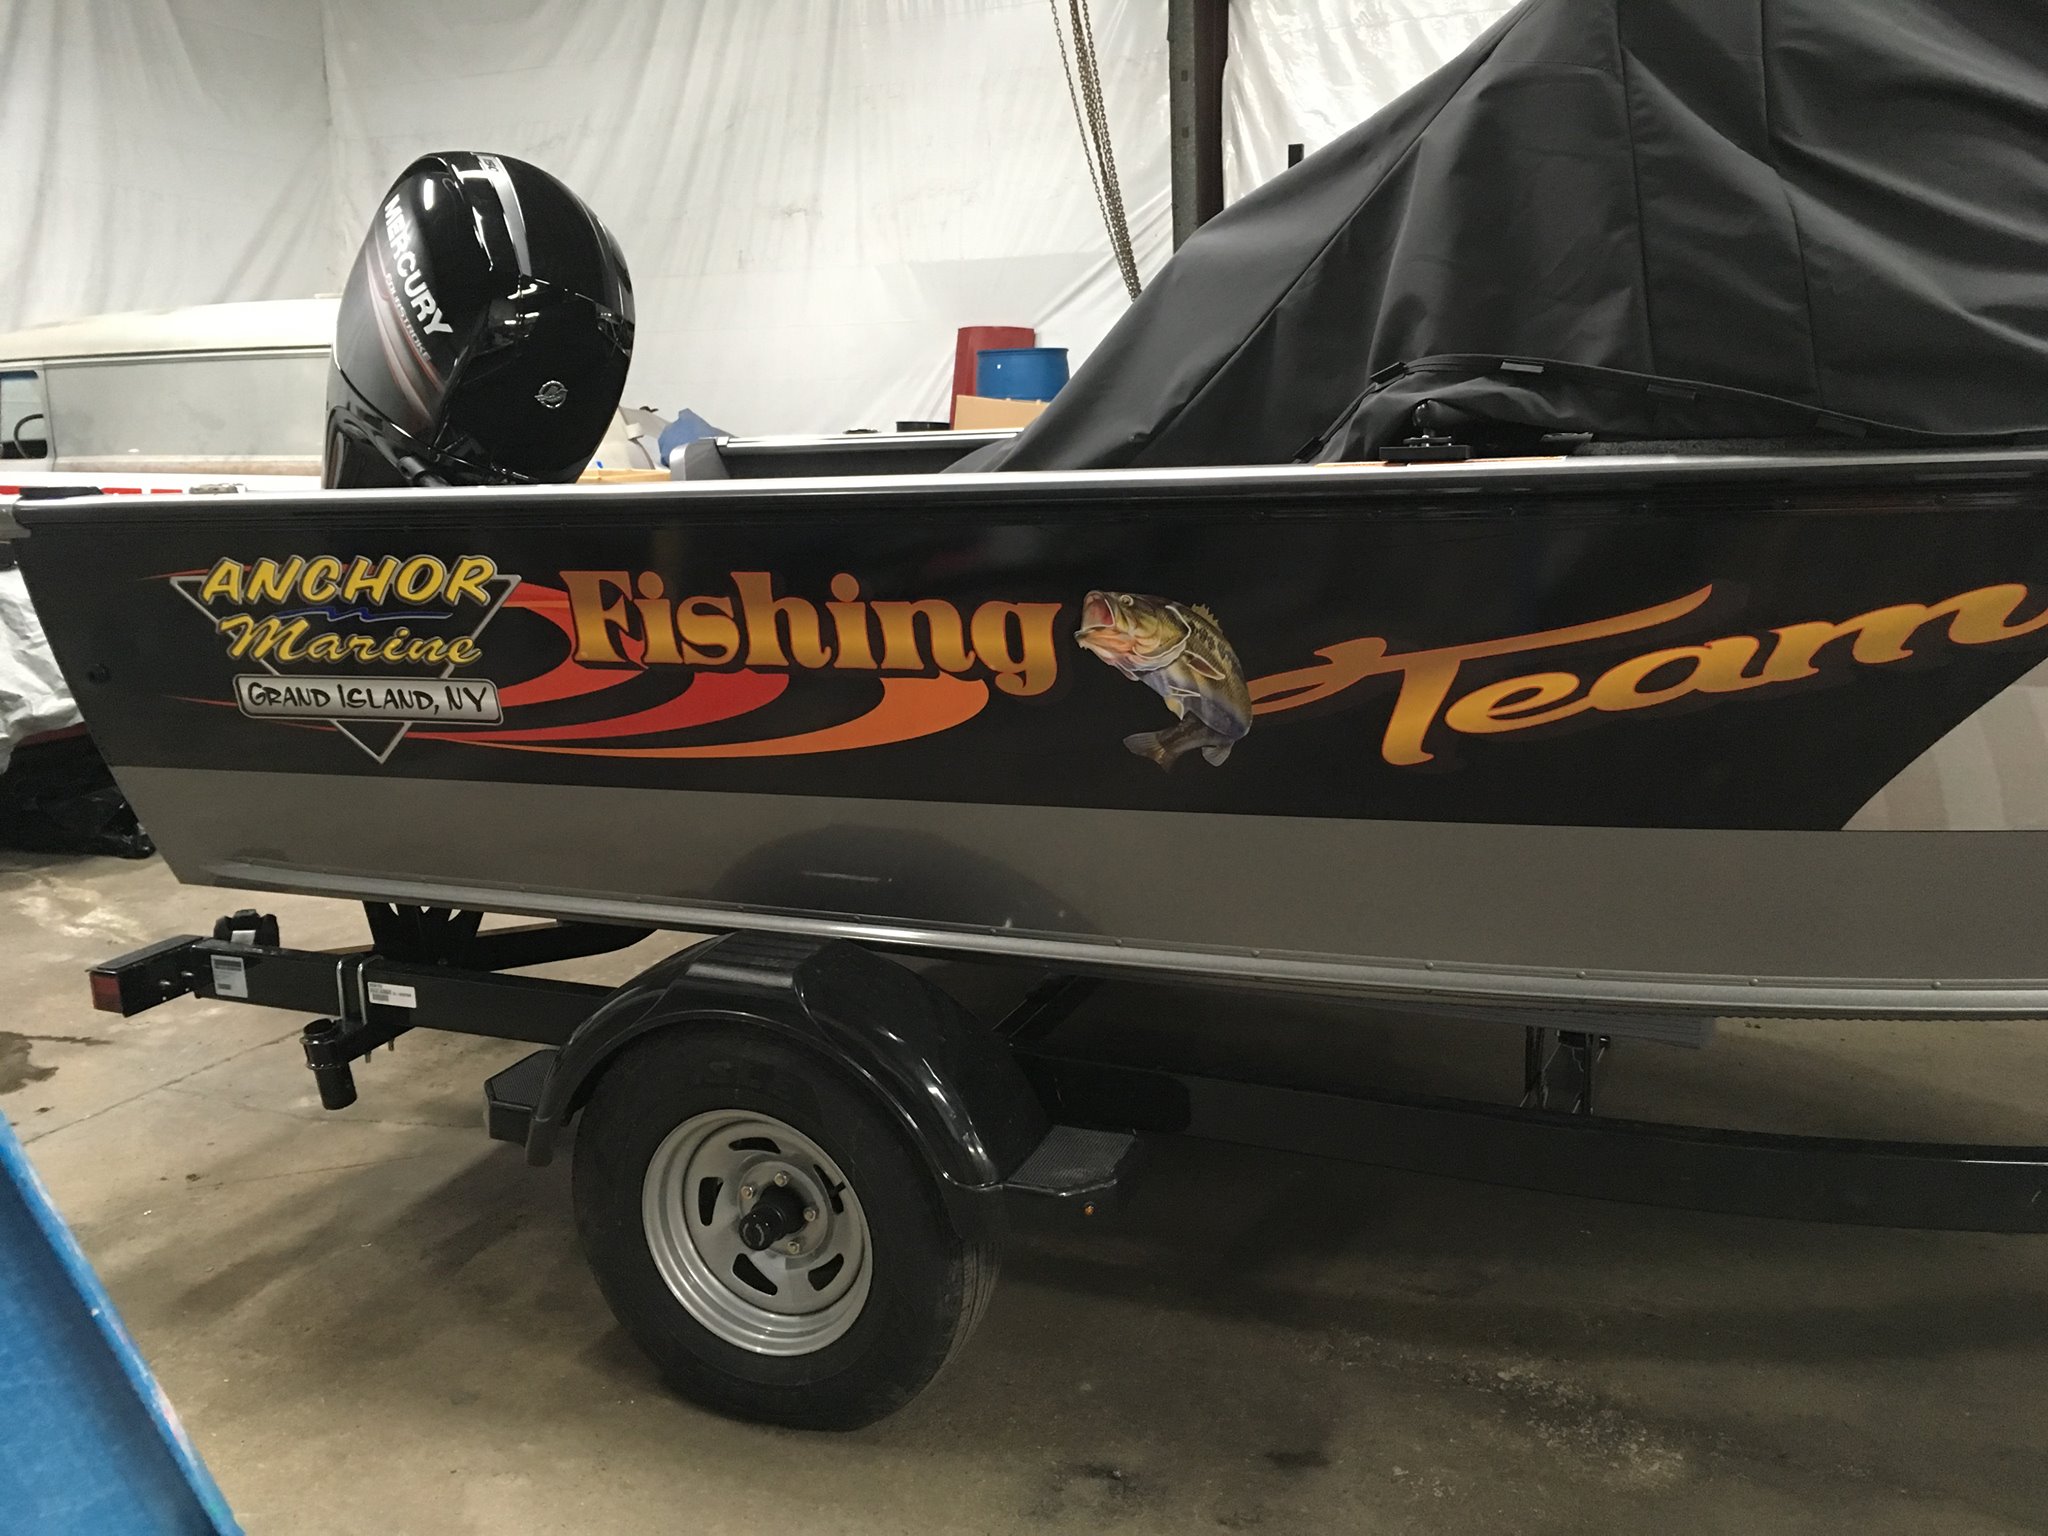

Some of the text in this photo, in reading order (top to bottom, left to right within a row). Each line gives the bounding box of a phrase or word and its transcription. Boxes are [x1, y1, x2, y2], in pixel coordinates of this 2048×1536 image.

[385, 193, 453, 335] MERCURY
[201, 554, 498, 606] ANCHOR
[217, 613, 483, 666] Marine
[559, 570, 2048, 766] Fishing Team
[247, 682, 488, 716] GRAND ISLAND, NY
